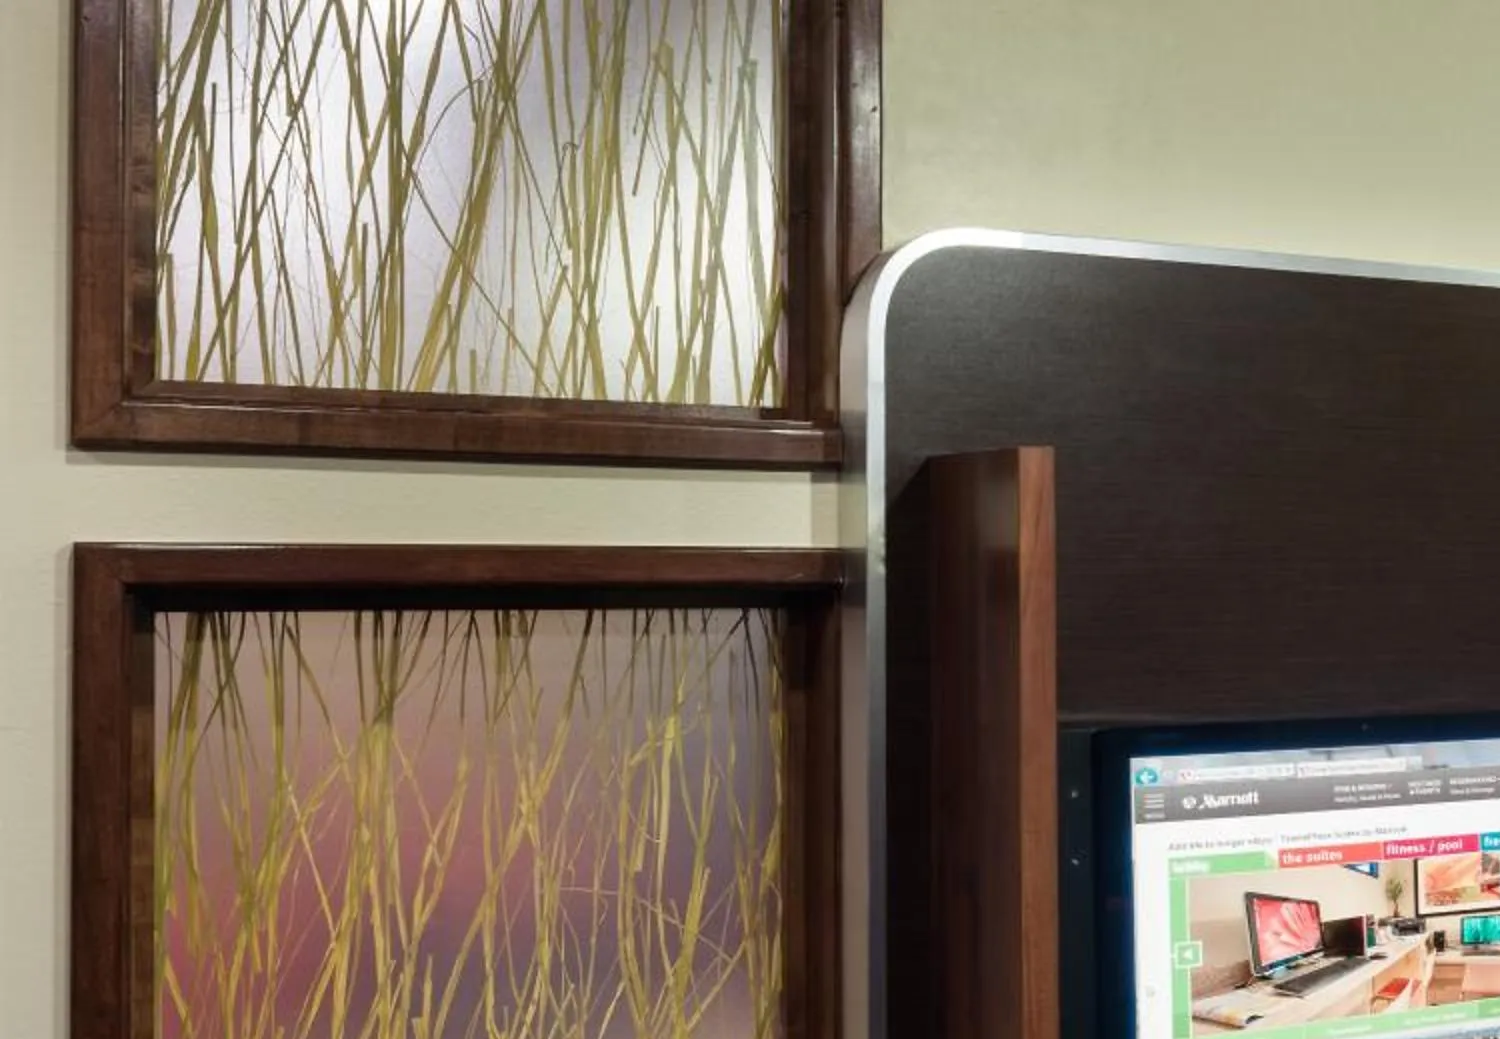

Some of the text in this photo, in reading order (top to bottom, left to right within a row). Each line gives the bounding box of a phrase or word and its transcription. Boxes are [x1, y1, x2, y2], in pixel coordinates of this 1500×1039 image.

[1386, 843, 1426, 855] fitness
[1438, 840, 1463, 854] pool
[1283, 849, 1343, 865] the suites
